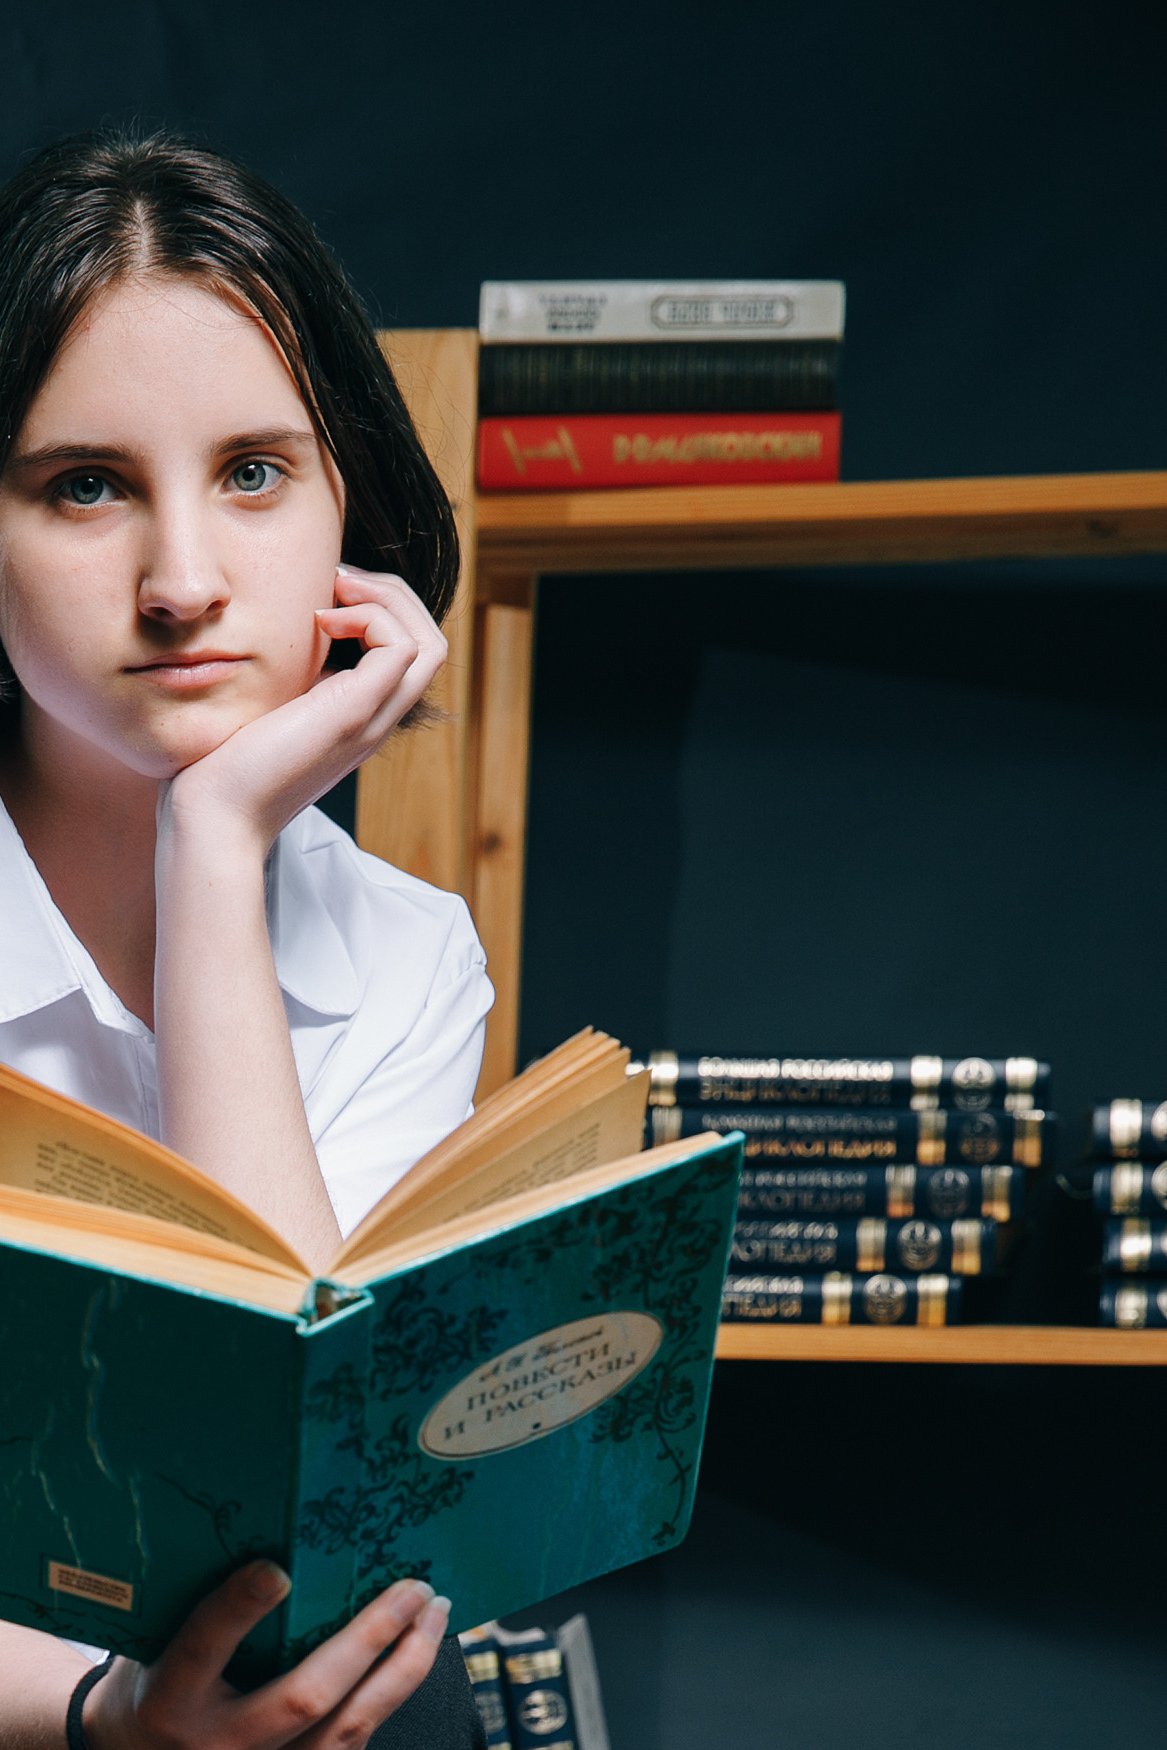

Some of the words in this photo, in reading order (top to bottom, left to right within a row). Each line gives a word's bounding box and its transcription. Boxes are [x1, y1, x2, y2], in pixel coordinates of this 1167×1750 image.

[443, 1420, 466, 1441] И
[485, 1350, 636, 1422] РАССКАЗЫ
[466, 1342, 610, 1412] ПОВЕСТИ
